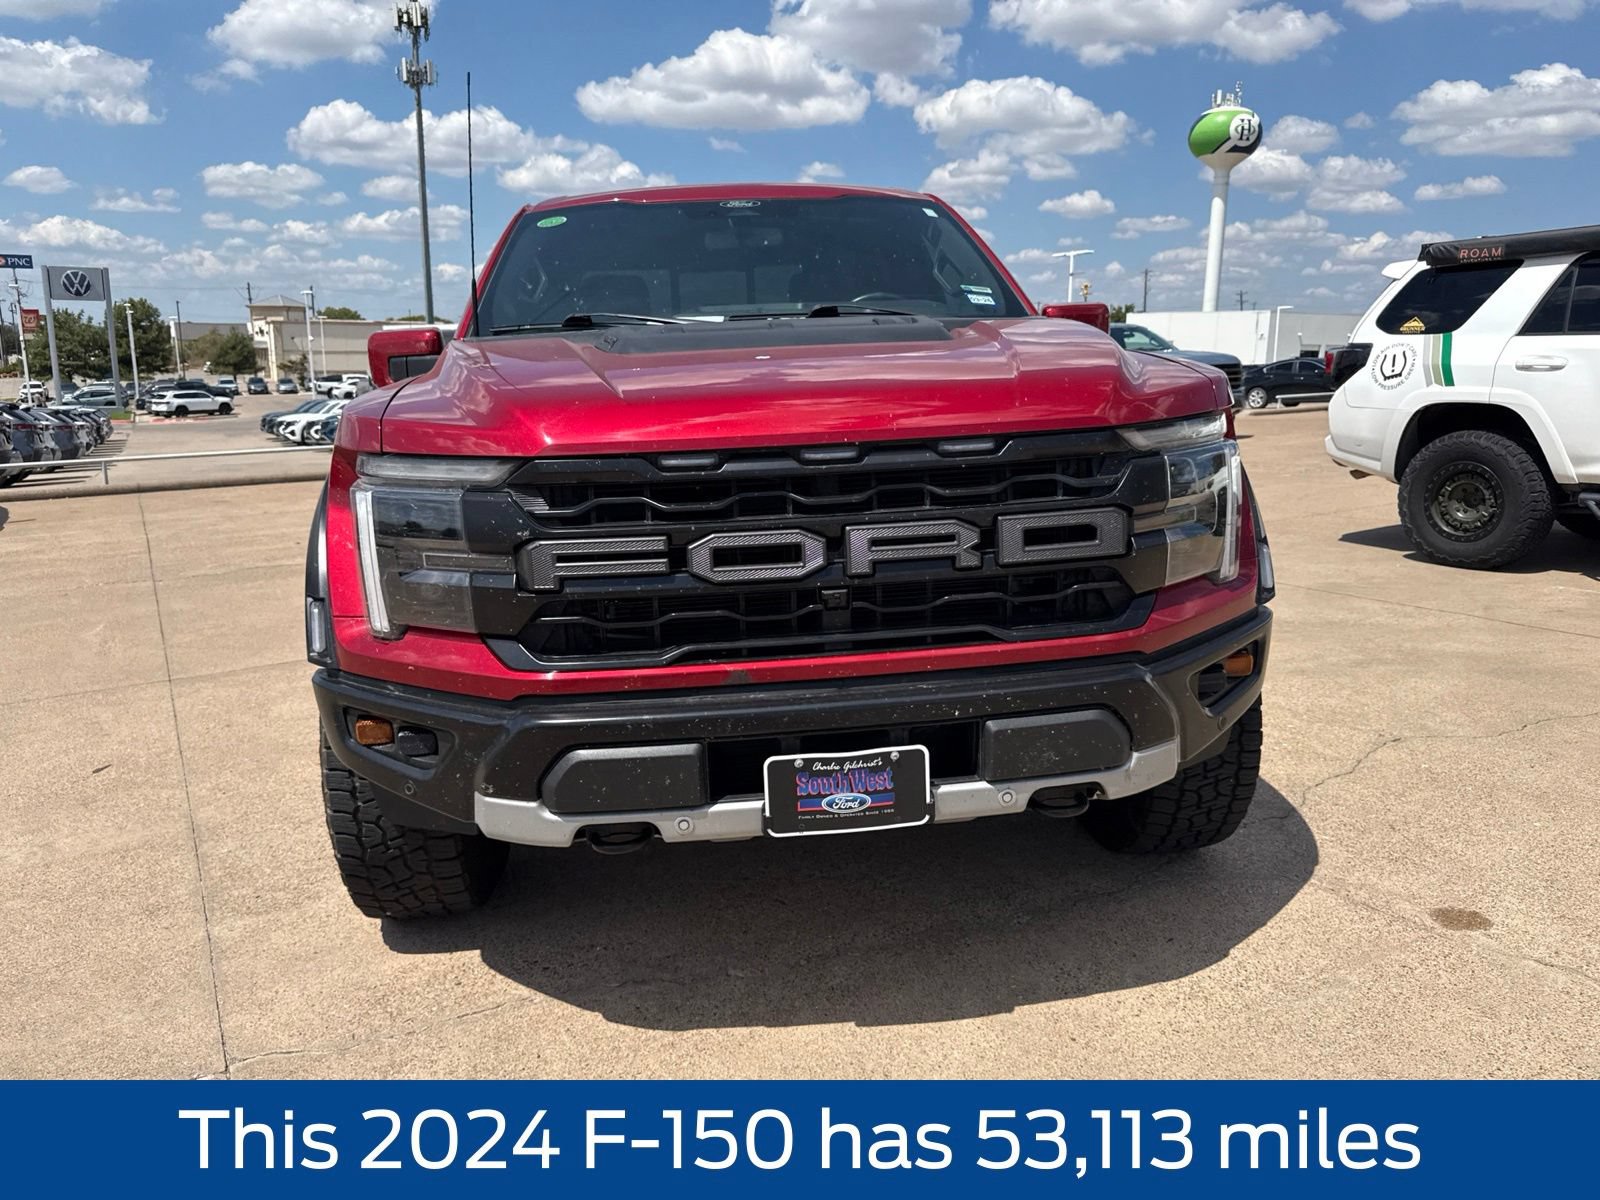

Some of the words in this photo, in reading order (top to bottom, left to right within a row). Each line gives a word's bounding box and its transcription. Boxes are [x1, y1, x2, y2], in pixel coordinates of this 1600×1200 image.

[1460, 247, 1502, 259] ROAM
[7, 257, 30, 266] PNC
[519, 507, 1129, 591] FORD
[812, 761, 841, 771] Charlie
[843, 756, 883, 773] Gilchrist's
[832, 796, 860, 810] Ford
